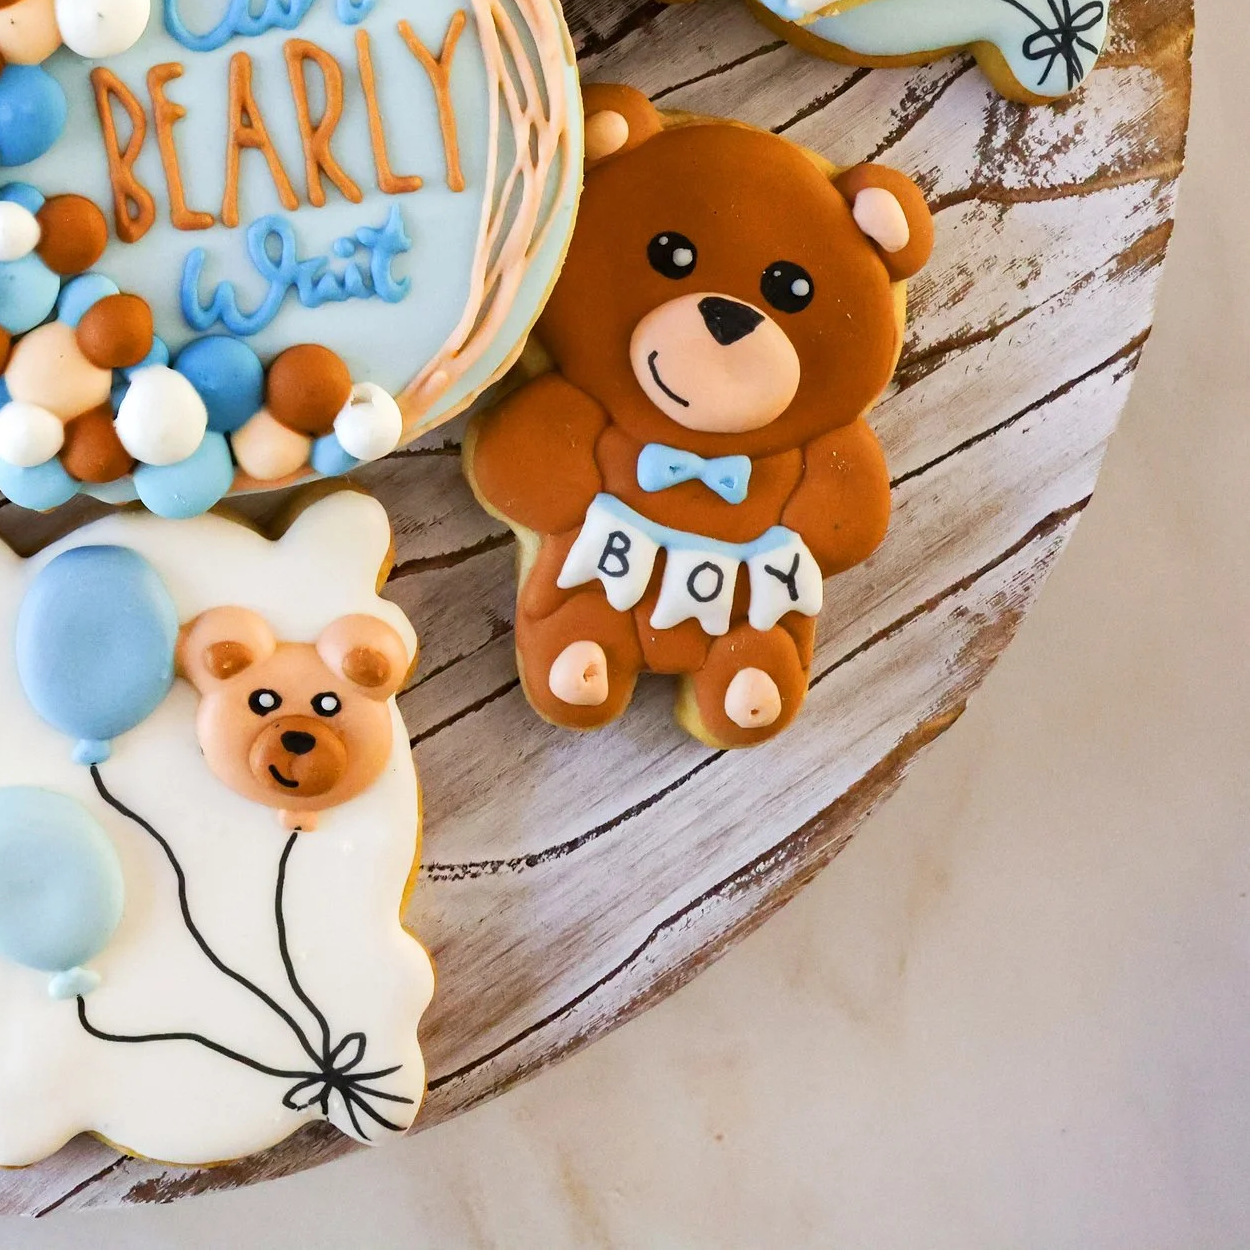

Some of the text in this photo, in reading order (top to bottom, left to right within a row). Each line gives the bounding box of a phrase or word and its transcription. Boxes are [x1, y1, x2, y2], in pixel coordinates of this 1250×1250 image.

[90, 9, 467, 243] BEARLY
[181, 202, 412, 336] Wait
[597, 530, 800, 602] BOY
